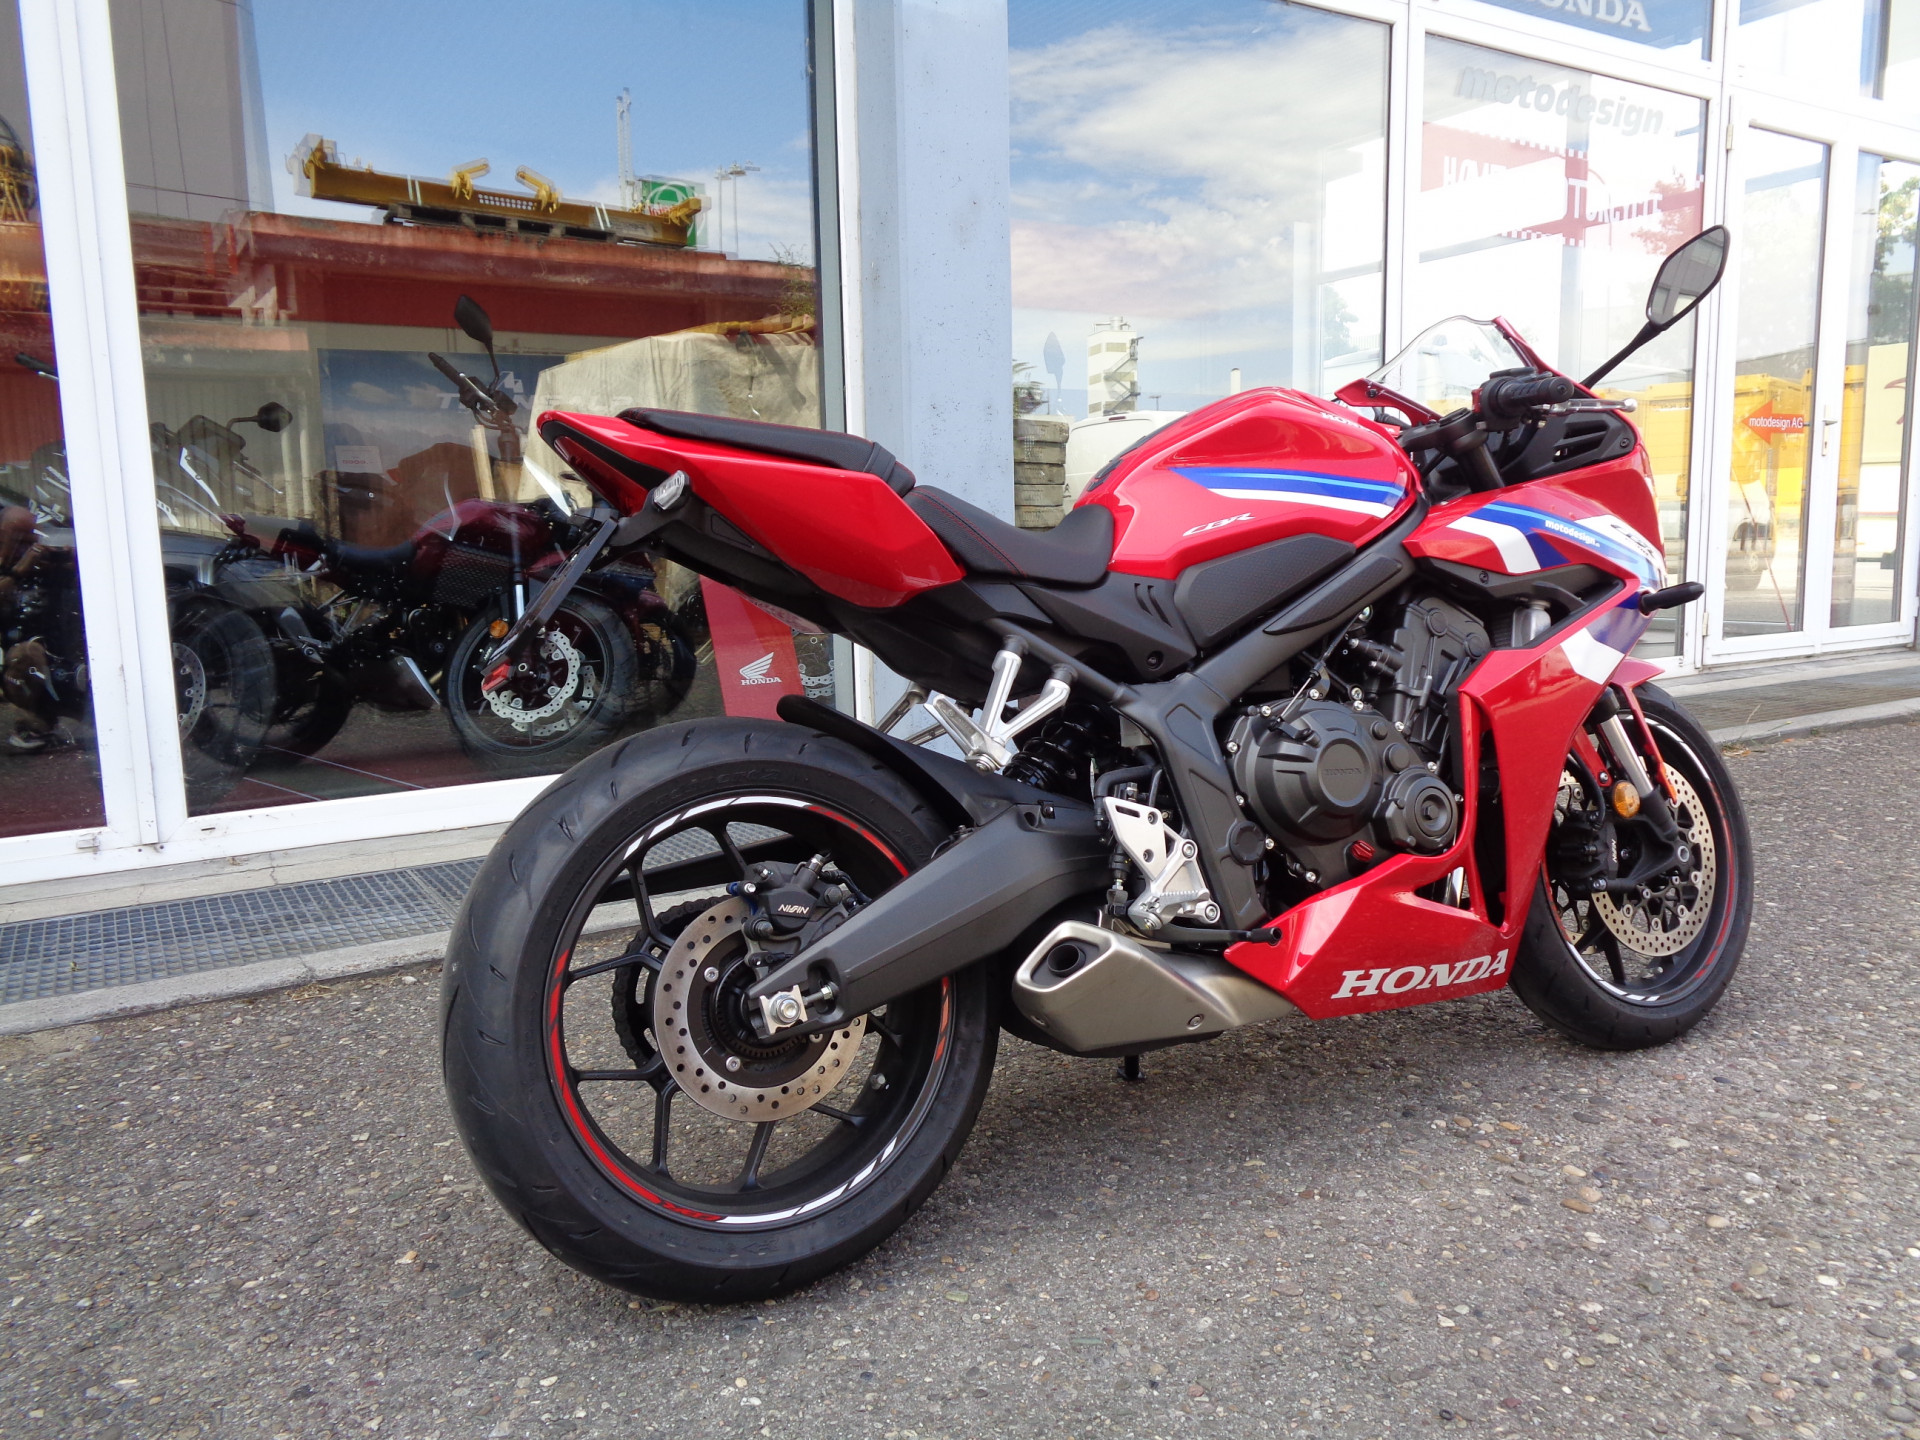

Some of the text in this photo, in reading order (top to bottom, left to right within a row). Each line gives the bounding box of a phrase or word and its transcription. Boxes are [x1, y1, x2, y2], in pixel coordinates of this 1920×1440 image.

[1456, 65, 1664, 136] motodesign
[1749, 416, 1804, 430] motodesign AG
[1182, 512, 1256, 537] CBR
[741, 676, 783, 686] HONDA
[778, 903, 810, 915] NISSIN
[1330, 948, 1509, 1000] HONDA
